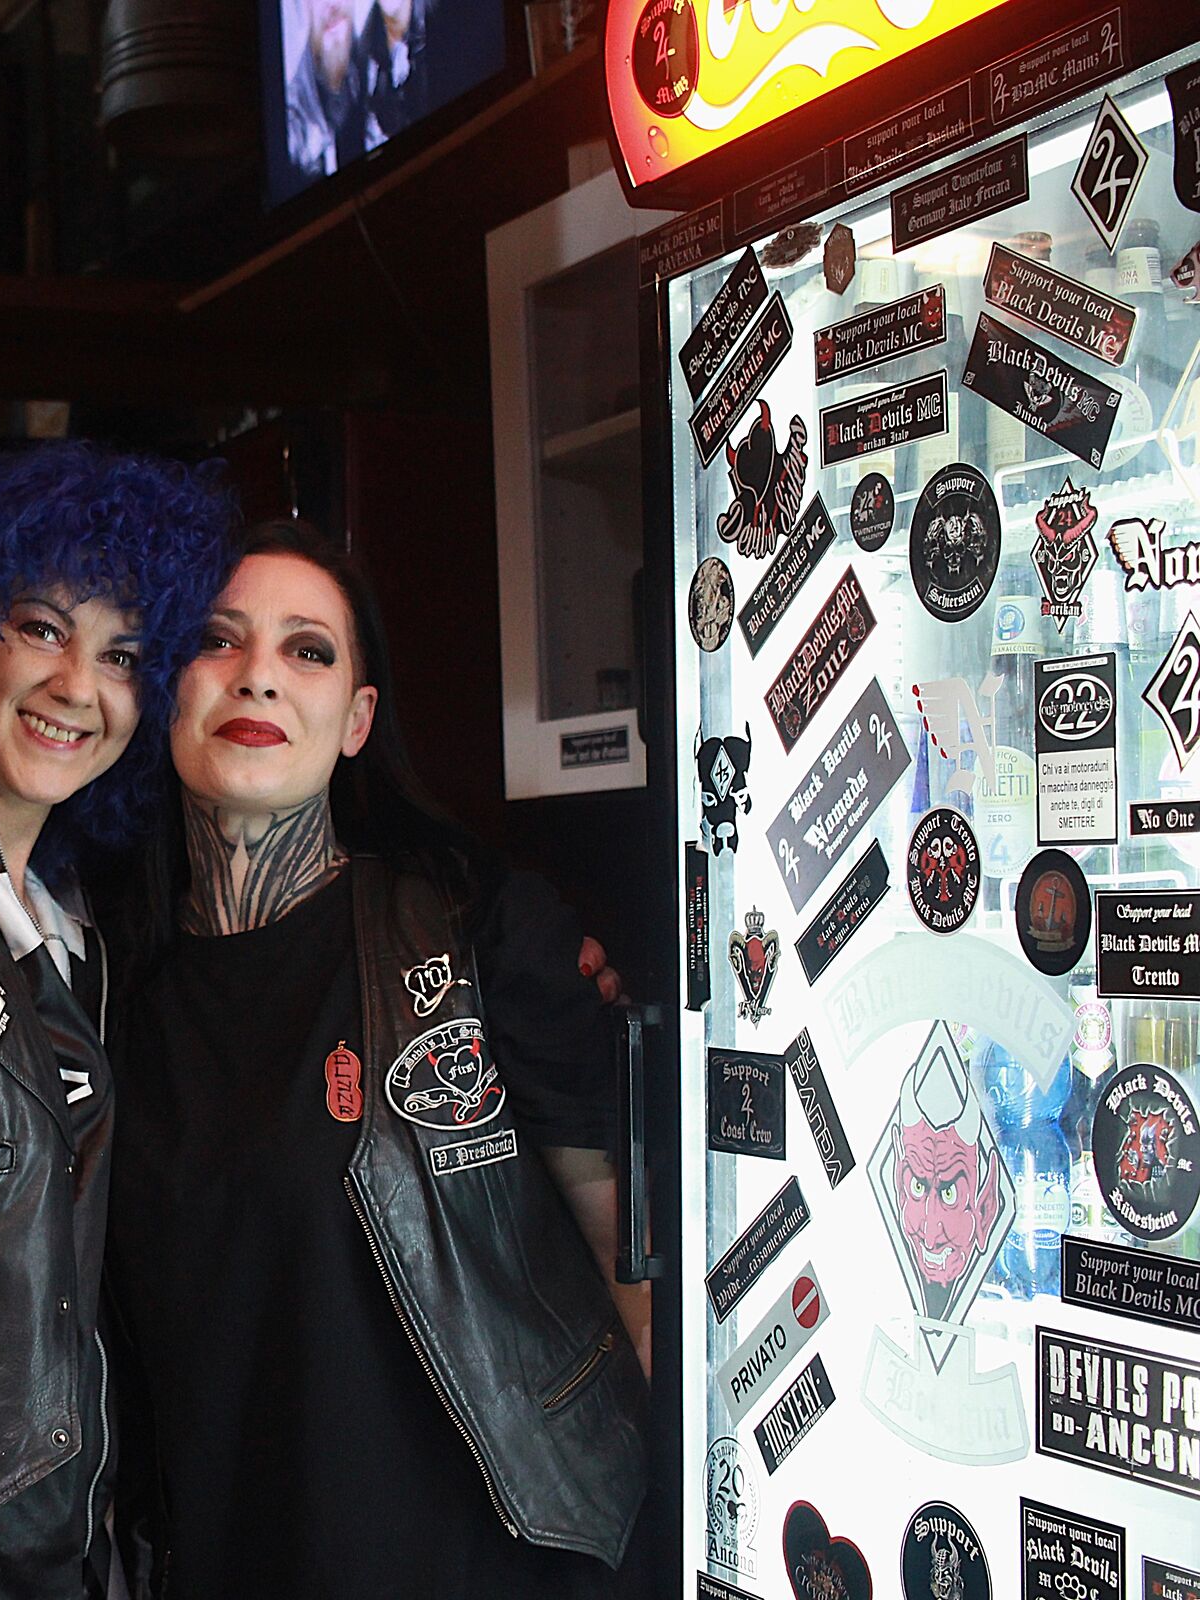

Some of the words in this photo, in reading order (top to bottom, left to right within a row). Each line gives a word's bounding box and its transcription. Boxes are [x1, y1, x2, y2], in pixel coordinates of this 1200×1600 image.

[912, 182, 949, 210] Support
[1009, 259, 1054, 292] Support
[1054, 281, 1083, 307] your
[1082, 292, 1115, 322] local
[835, 320, 871, 344] Support
[873, 312, 895, 334] your
[897, 299, 922, 321] local
[995, 281, 1035, 316] Black
[1037, 302, 1085, 341] Devils
[762, 319, 783, 354] MC
[834, 343, 864, 370] Black
[865, 331, 900, 359] Devils
[902, 321, 923, 346] MC
[688, 338, 714, 379] Black
[704, 340, 731, 378] Coast
[826, 418, 864, 447] Black
[868, 403, 913, 435] Devils
[917, 392, 943, 422] MC
[935, 477, 976, 498] Support
[747, 594, 777, 640] Black
[804, 516, 826, 550] MC
[752, 568, 779, 605] Support
[776, 551, 793, 575] your
[791, 520, 807, 547] local
[771, 590, 794, 623] Chapter
[928, 584, 981, 610] Schierstein
[1054, 680, 1097, 731] 22
[1040, 782, 1046, 793] in
[1046, 780, 1078, 793] macchina
[1079, 779, 1114, 793] danneggia
[1042, 763, 1052, 776] Chi
[1053, 765, 1062, 775] va
[1063, 763, 1070, 774] ai
[1070, 759, 1109, 774] motoraduni
[788, 772, 824, 825] Black
[1050, 800, 1070, 811] anche
[1137, 808, 1161, 829] No
[1165, 808, 1195, 828] One
[909, 813, 941, 867] Support
[950, 814, 977, 863] Trento
[1058, 815, 1095, 829] SMETTERE
[909, 878, 931, 922] Black
[931, 906, 966, 928] Devils
[1116, 903, 1152, 923] Support
[1151, 908, 1172, 922] your
[1172, 903, 1193, 919] local
[1100, 933, 1136, 953] Black
[1138, 934, 1181, 953] Devils
[1131, 965, 1180, 987] Trento
[448, 1061, 477, 1081] First
[723, 1064, 770, 1086] Support
[1105, 1073, 1148, 1115] Black
[1152, 1074, 1197, 1136] Devils
[720, 1116, 747, 1141] Coast
[749, 1121, 772, 1144] Crew
[456, 1138, 514, 1167] Presidente
[1108, 1184, 1179, 1234] Rüdesheim
[722, 1240, 750, 1279] Support
[749, 1226, 766, 1251] your
[766, 1198, 785, 1227] local
[1080, 1250, 1130, 1277] Support
[1133, 1263, 1164, 1285] your
[1166, 1266, 1199, 1291] local
[1075, 1273, 1118, 1301] Black
[1121, 1282, 1172, 1313] Devils
[730, 1324, 786, 1403] PRIVATO
[1049, 1344, 1150, 1418] DEVILS
[762, 1366, 822, 1458] MISTERY
[914, 1515, 980, 1561] Support
[1027, 1512, 1067, 1536] Support
[1069, 1527, 1092, 1544] your
[1094, 1532, 1117, 1552] local
[708, 1538, 755, 1574] Ancona
[1026, 1537, 1066, 1563] Black
[1070, 1543, 1118, 1589] Devils
